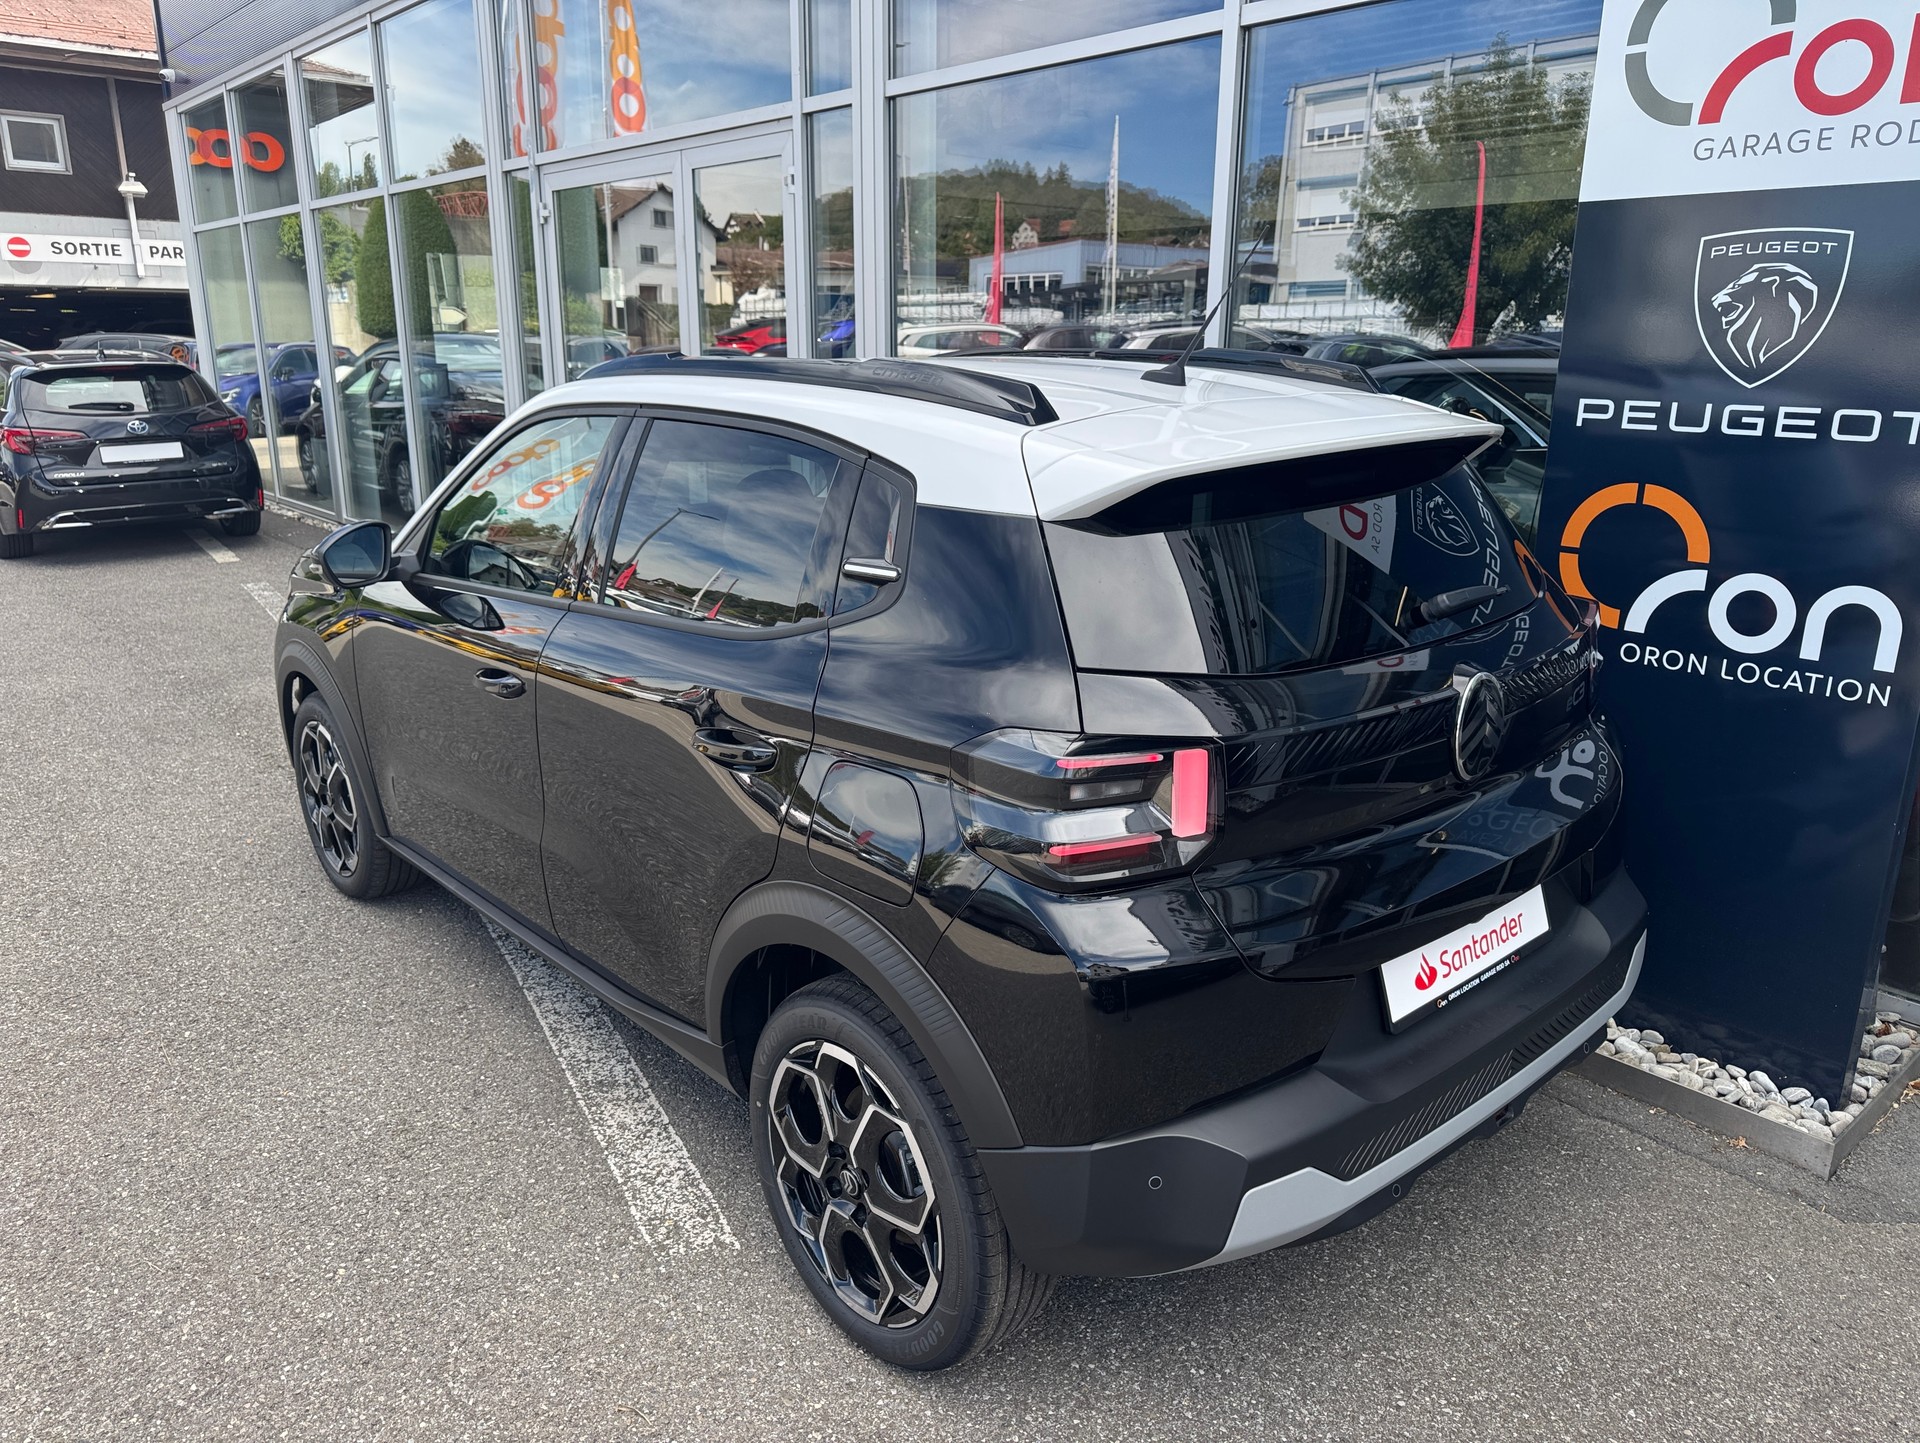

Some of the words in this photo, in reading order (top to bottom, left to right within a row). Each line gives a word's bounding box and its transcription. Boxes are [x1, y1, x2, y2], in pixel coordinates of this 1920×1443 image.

[1693, 126, 1835, 161] GARAGE
[50, 241, 122, 257] SORTIE
[149, 245, 184, 260] PAR
[1710, 241, 1838, 259] PEUGEOT
[1575, 398, 1920, 445] PEUGEOT
[1619, 642, 1708, 676] ORON
[1720, 658, 1892, 707] LOCATION
[1439, 912, 1523, 979] Santander
[1460, 977, 1480, 994] LOCATION
[1480, 967, 1497, 982] GARAGE
